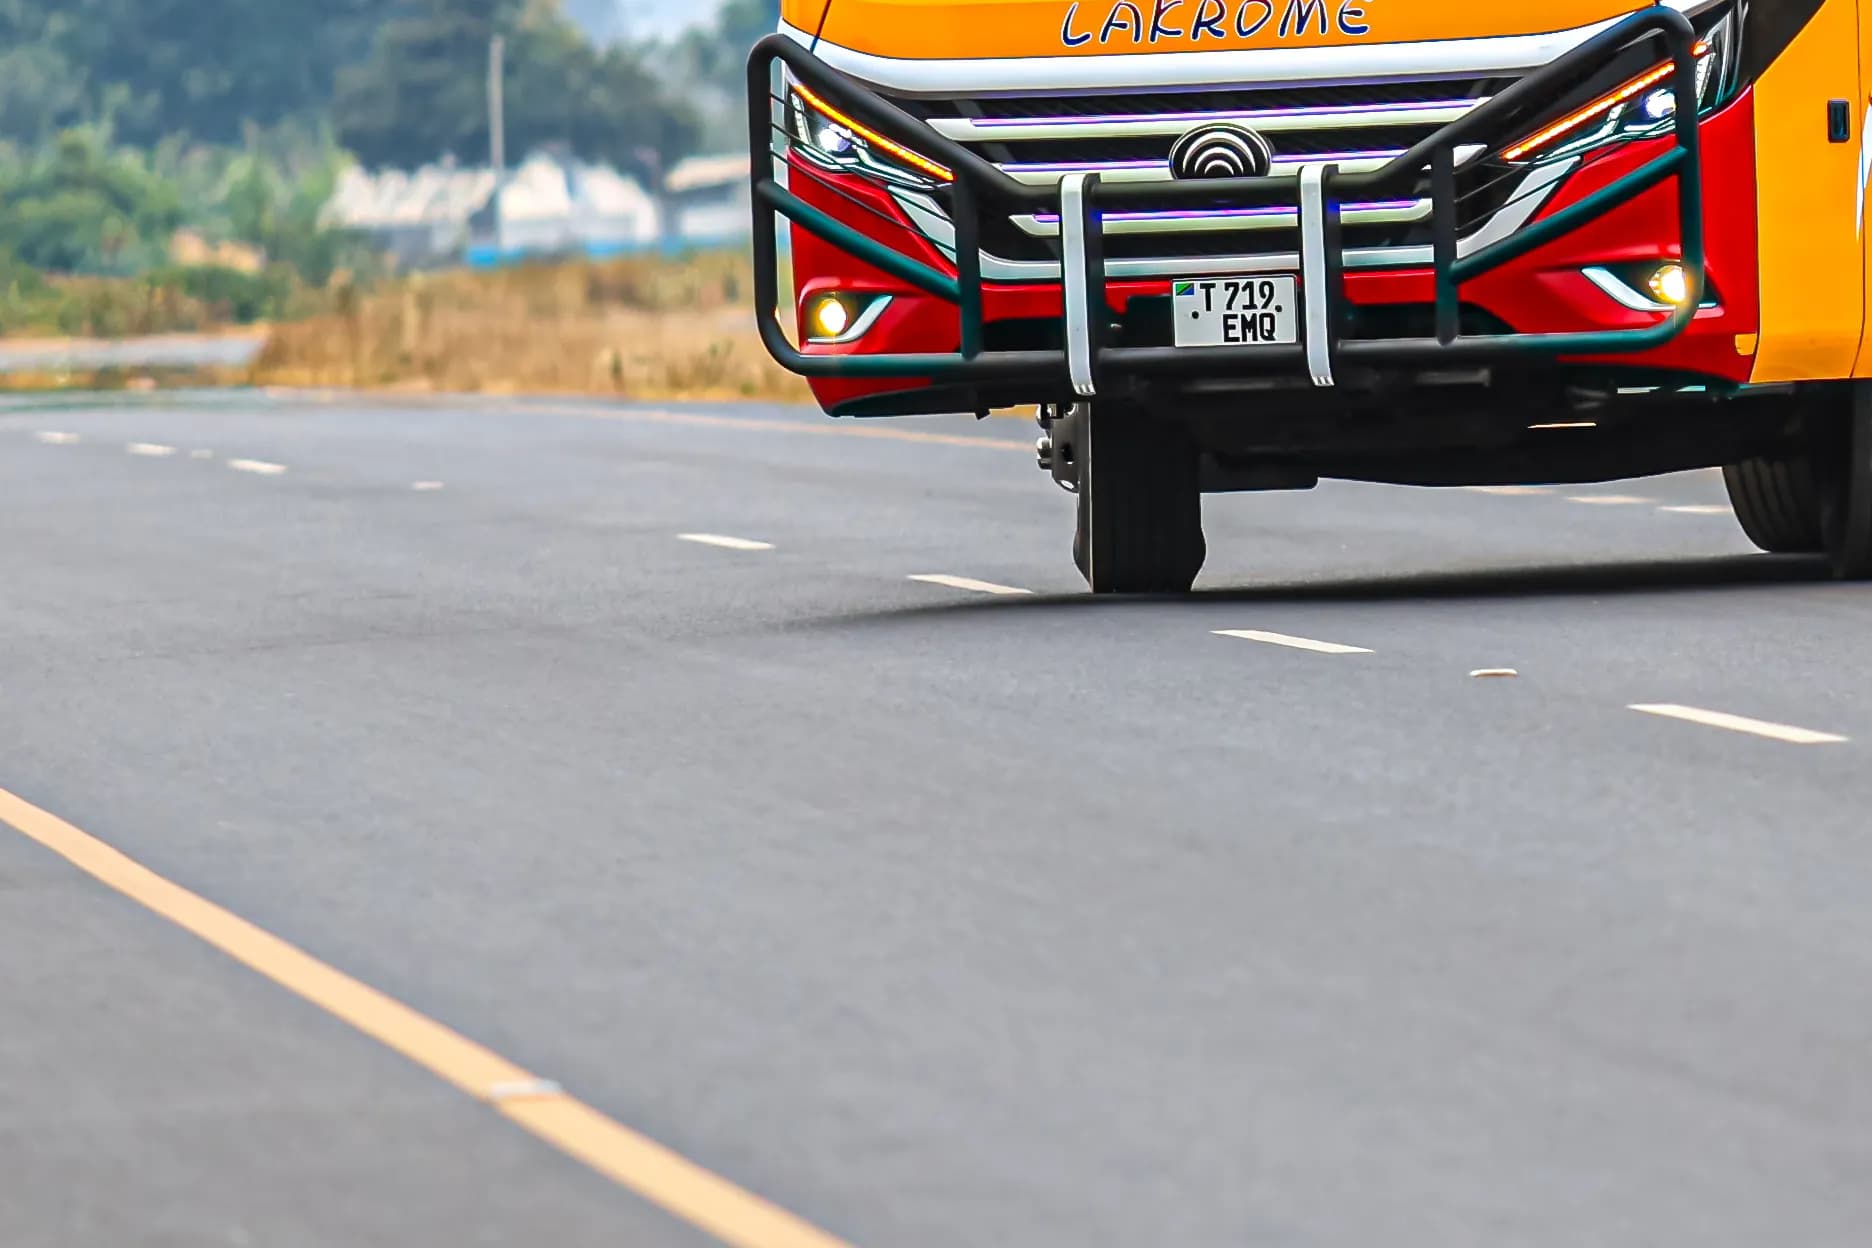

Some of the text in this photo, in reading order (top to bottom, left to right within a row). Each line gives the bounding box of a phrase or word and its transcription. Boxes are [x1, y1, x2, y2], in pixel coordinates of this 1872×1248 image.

[1199, 280, 1276, 312] T 719
[1222, 312, 1277, 343] EMQ
